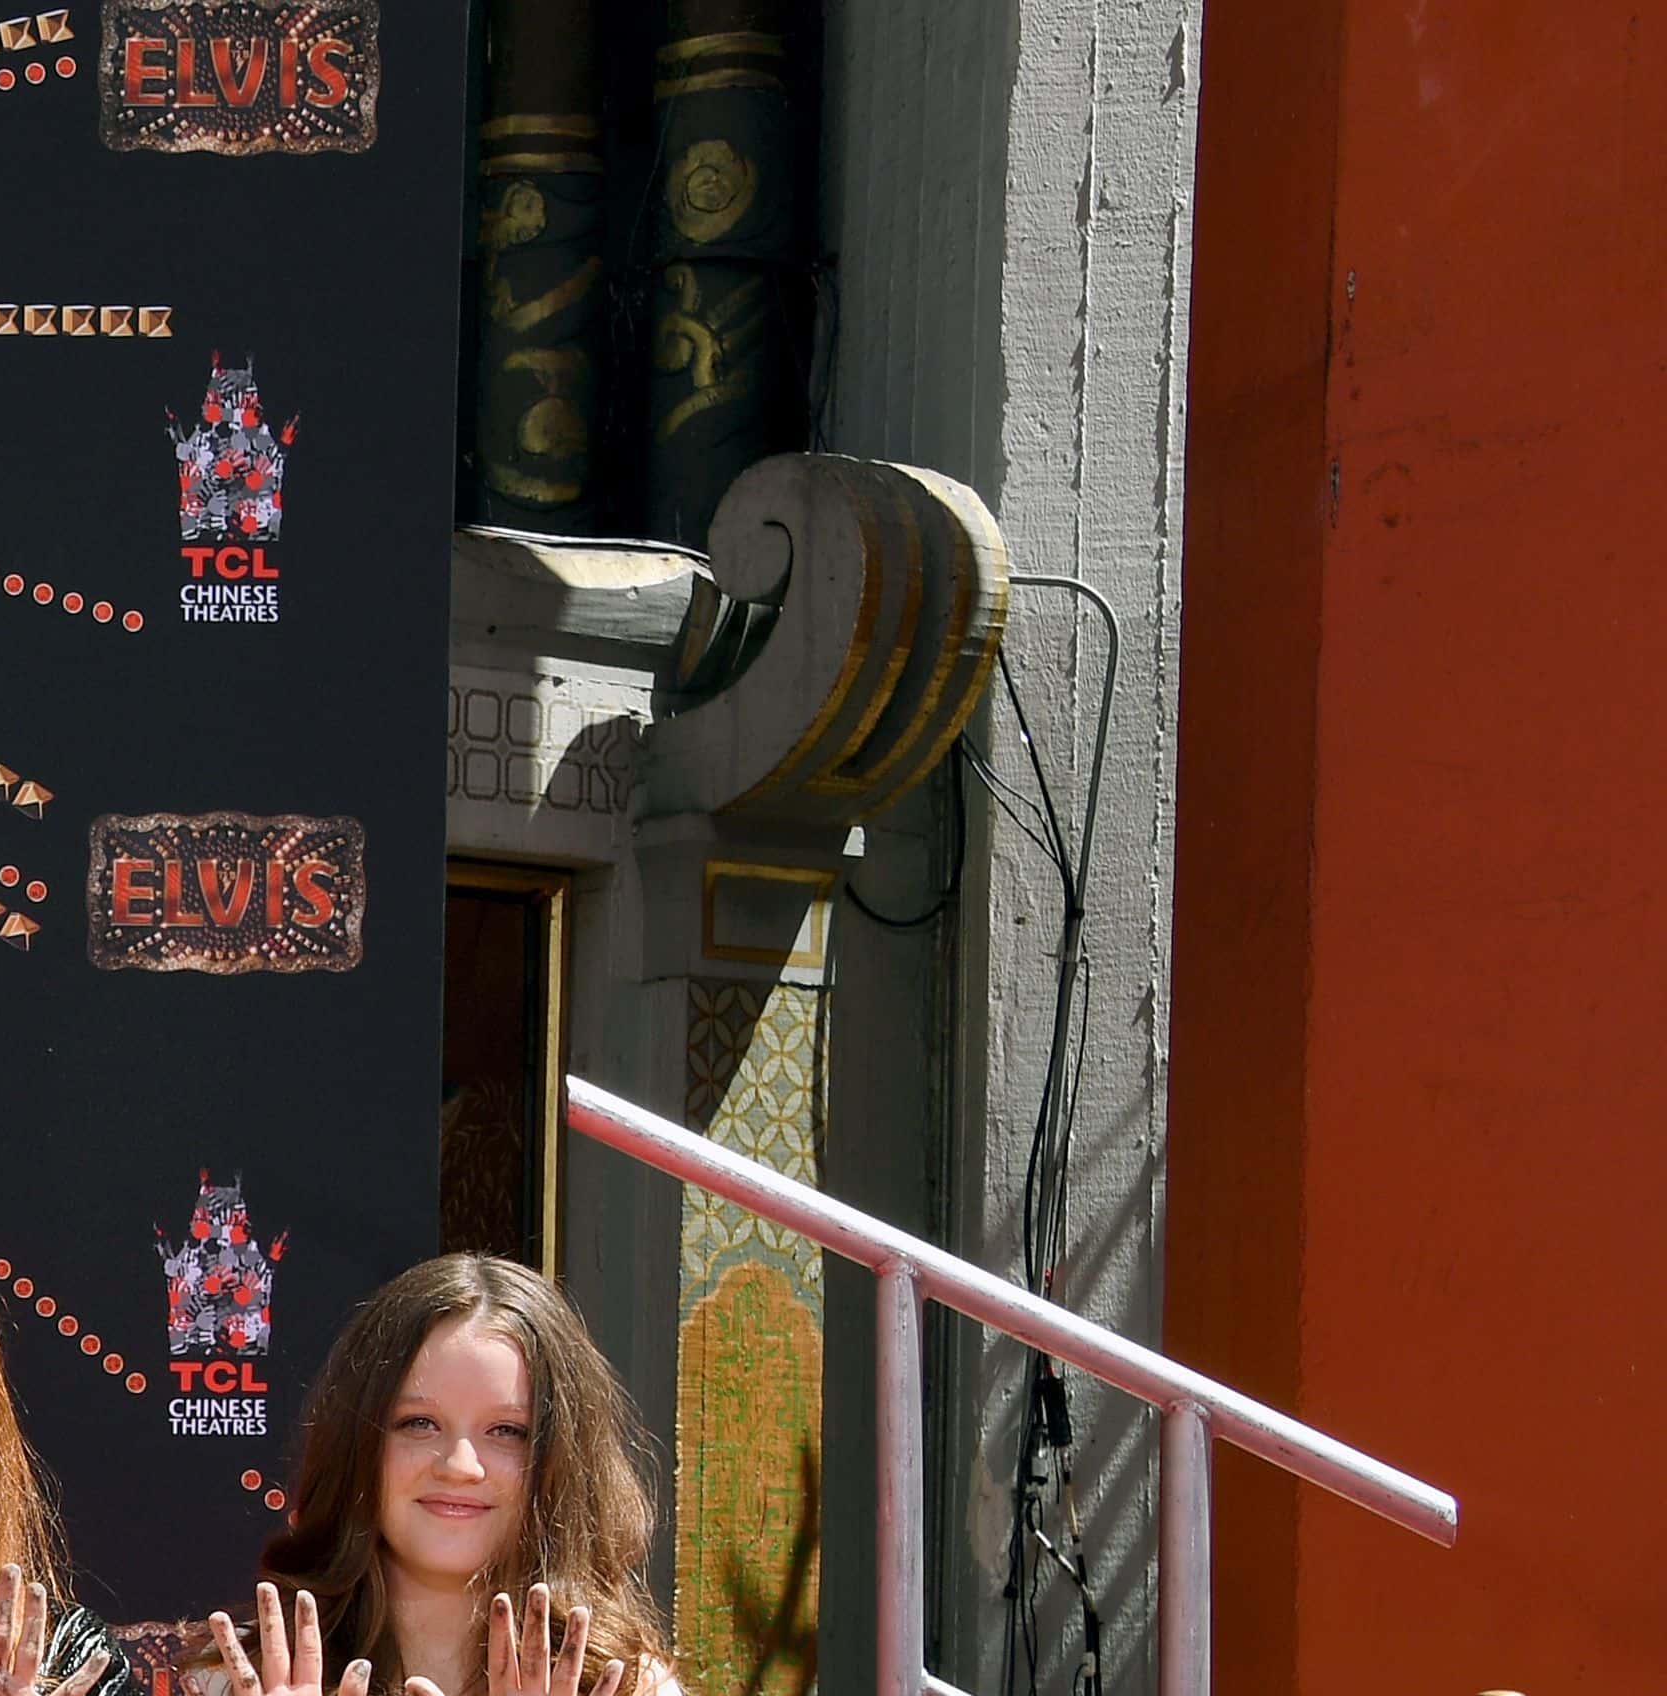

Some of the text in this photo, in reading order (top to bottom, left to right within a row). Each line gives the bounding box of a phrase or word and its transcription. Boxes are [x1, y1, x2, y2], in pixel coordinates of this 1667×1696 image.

[123, 37, 351, 108] ELVIS
[181, 547, 279, 579] TCL
[180, 585, 278, 605] CHINESE
[180, 605, 279, 622] THEATRES
[110, 857, 337, 929] ELVIS
[169, 1361, 268, 1393] TCL
[168, 1399, 267, 1418] CHINESE
[168, 1418, 267, 1436] THEATRES
